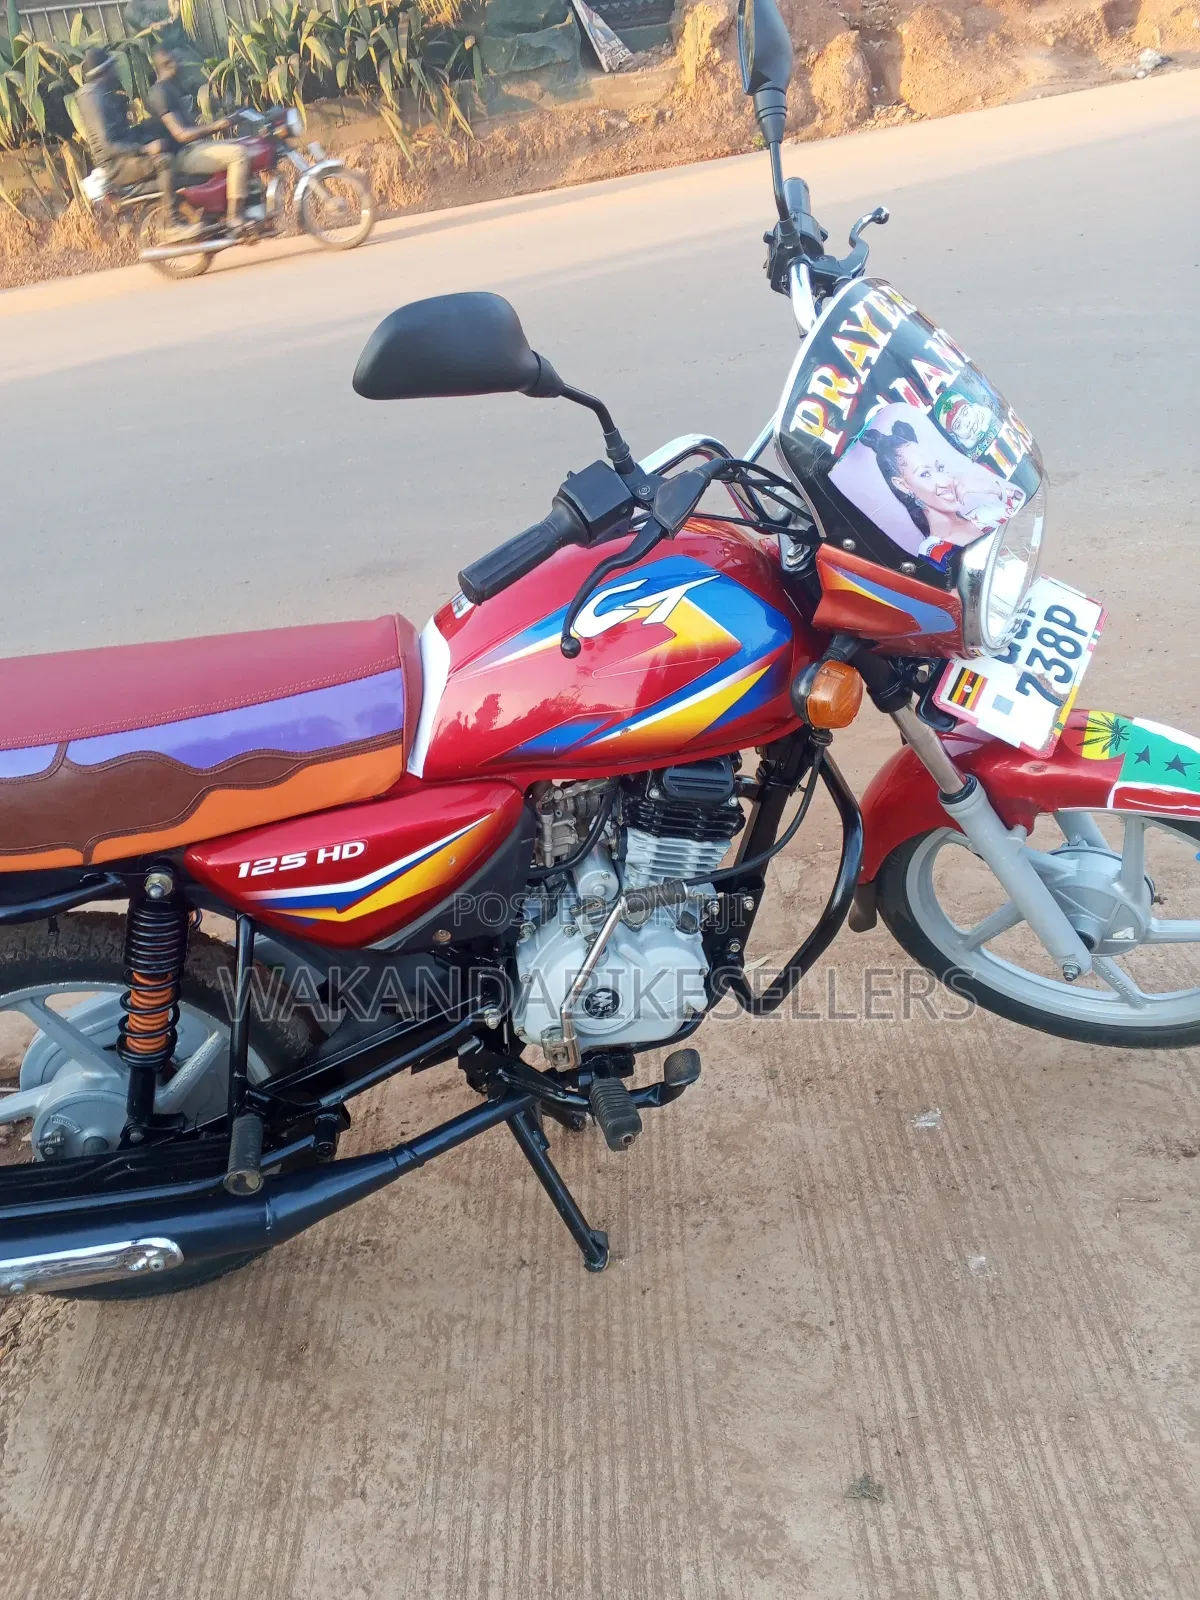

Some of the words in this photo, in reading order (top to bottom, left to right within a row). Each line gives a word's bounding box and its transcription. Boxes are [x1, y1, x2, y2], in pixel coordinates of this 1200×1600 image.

[1015, 604, 1089, 708] 738P
[237, 851, 308, 879] 125
[316, 841, 367, 865] HD
